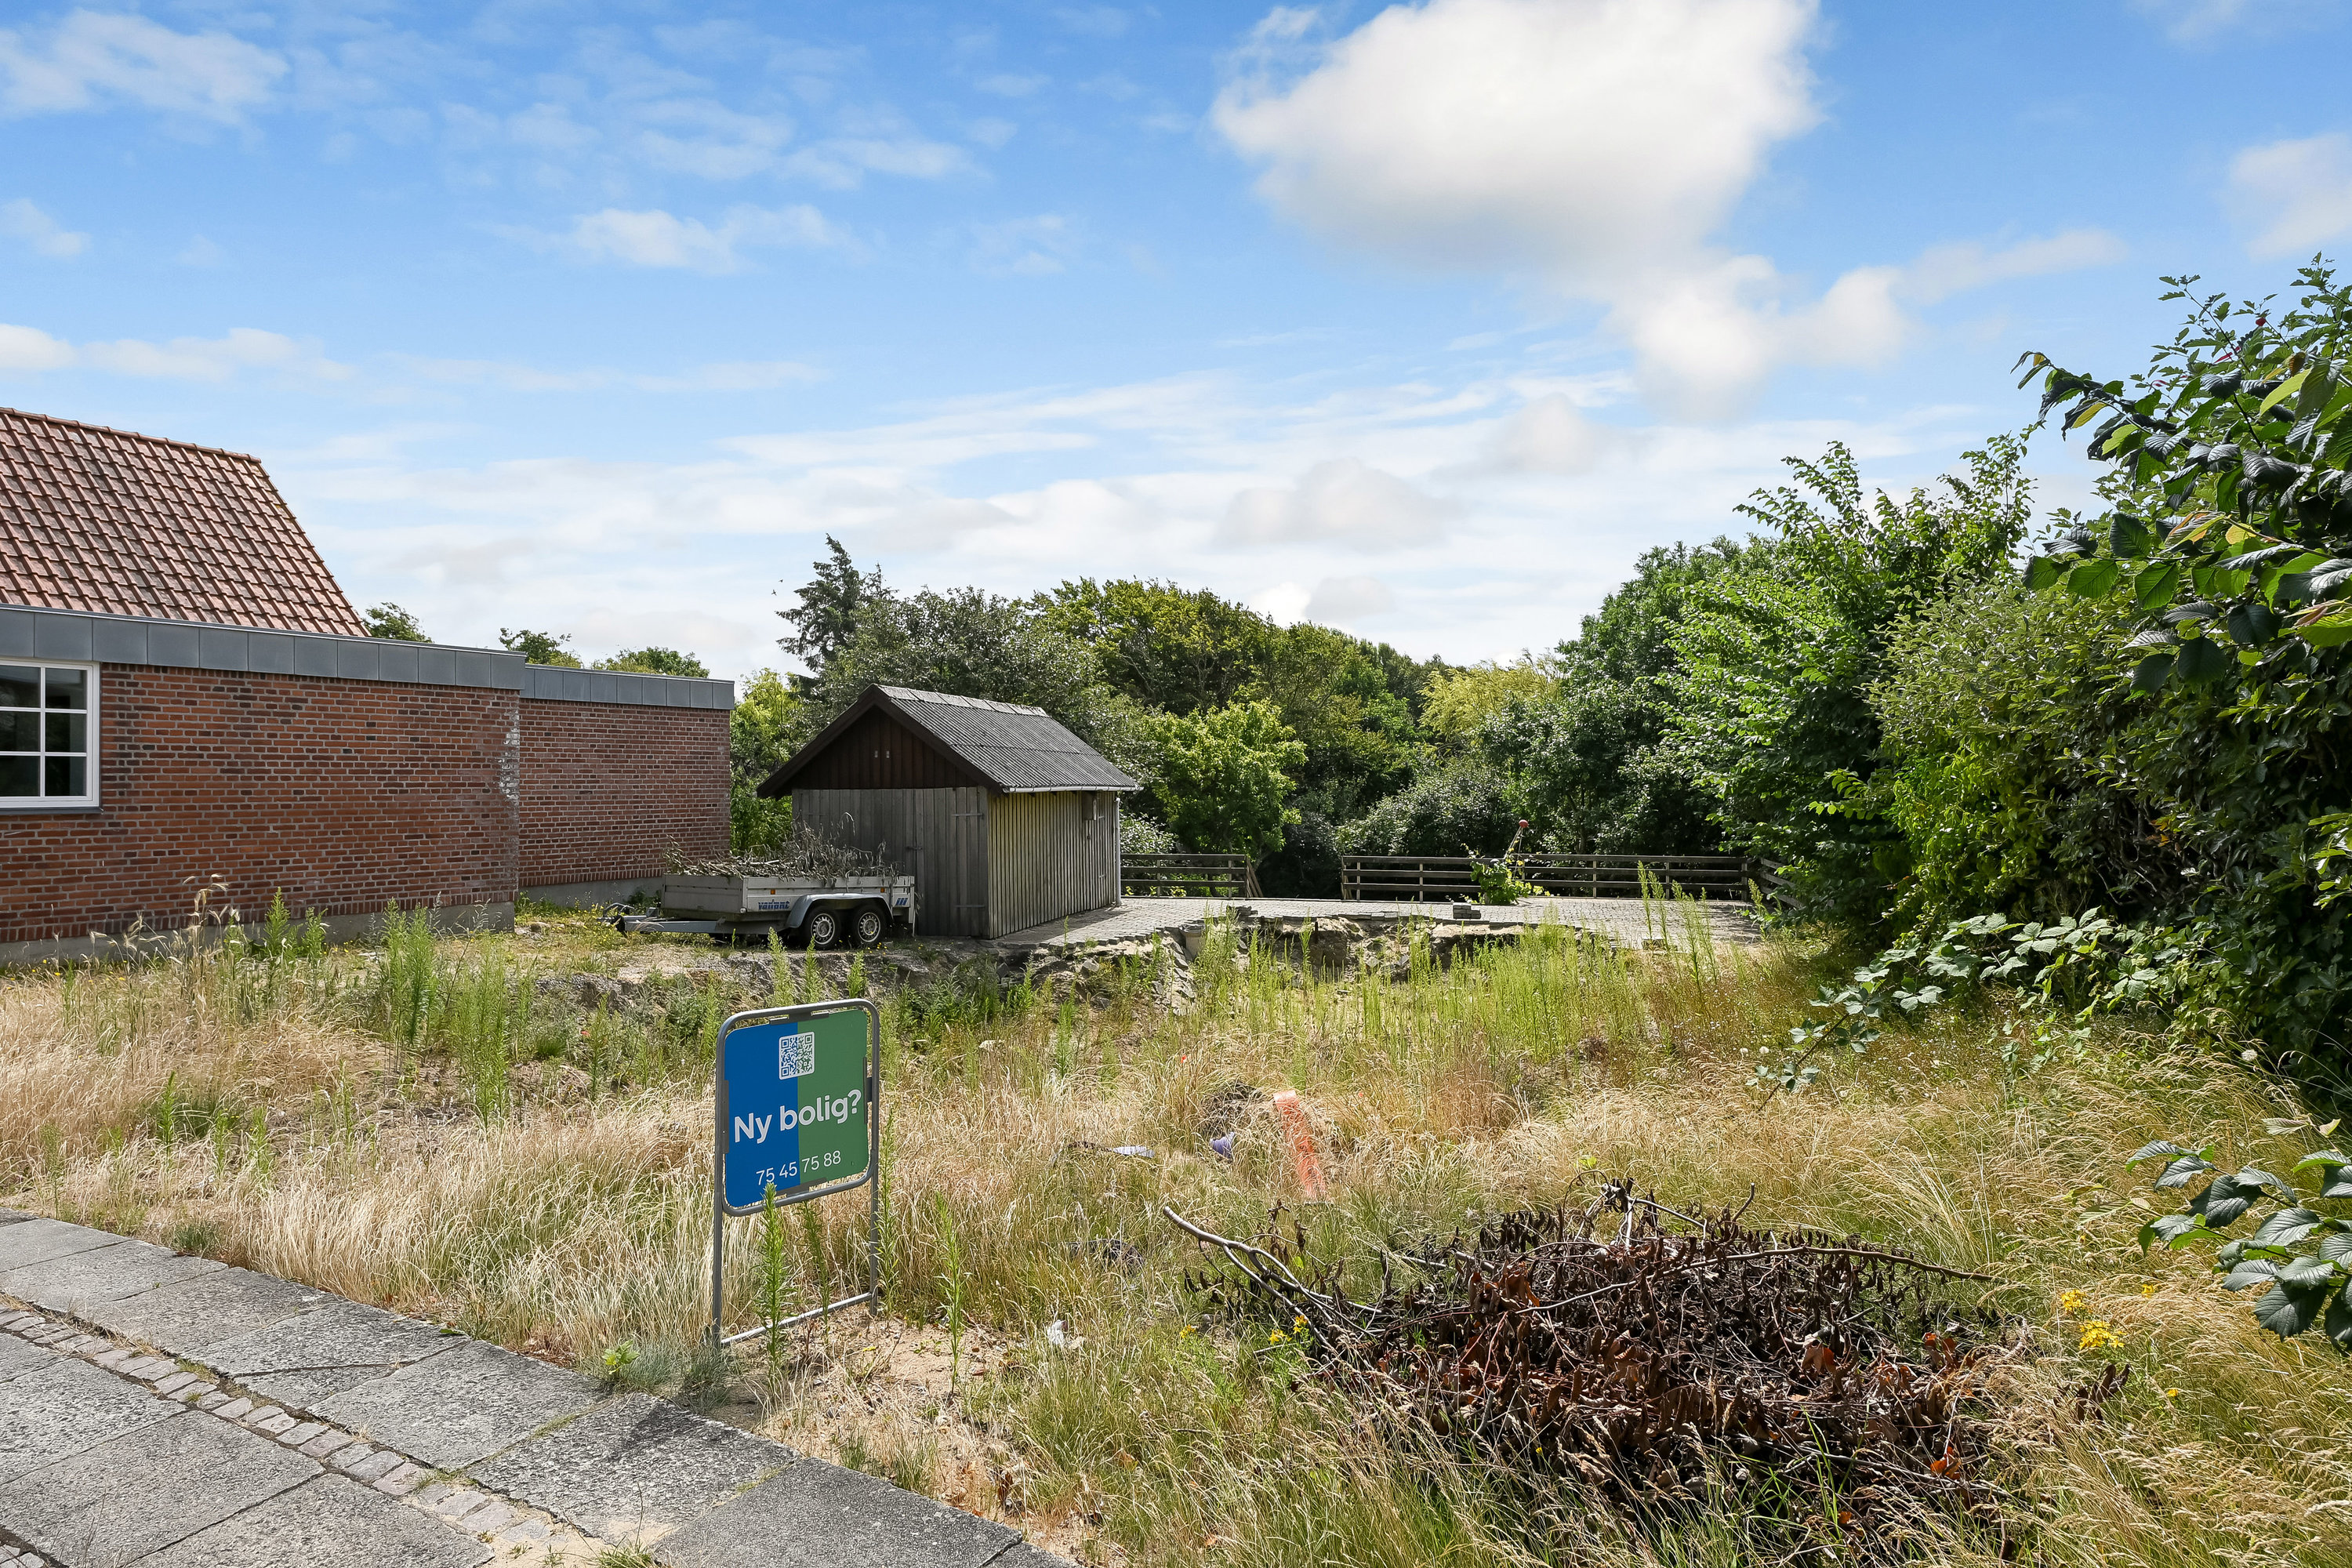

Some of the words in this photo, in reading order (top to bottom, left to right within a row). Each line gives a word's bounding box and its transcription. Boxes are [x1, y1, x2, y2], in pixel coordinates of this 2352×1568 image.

[758, 898, 790, 909] variant
[735, 1112, 772, 1144] Ny
[779, 1089, 862, 1131] bolig?
[756, 1167, 775, 1185] 75
[779, 1161, 797, 1178] 45
[801, 1155, 819, 1173] 75
[823, 1150, 841, 1167] 88
